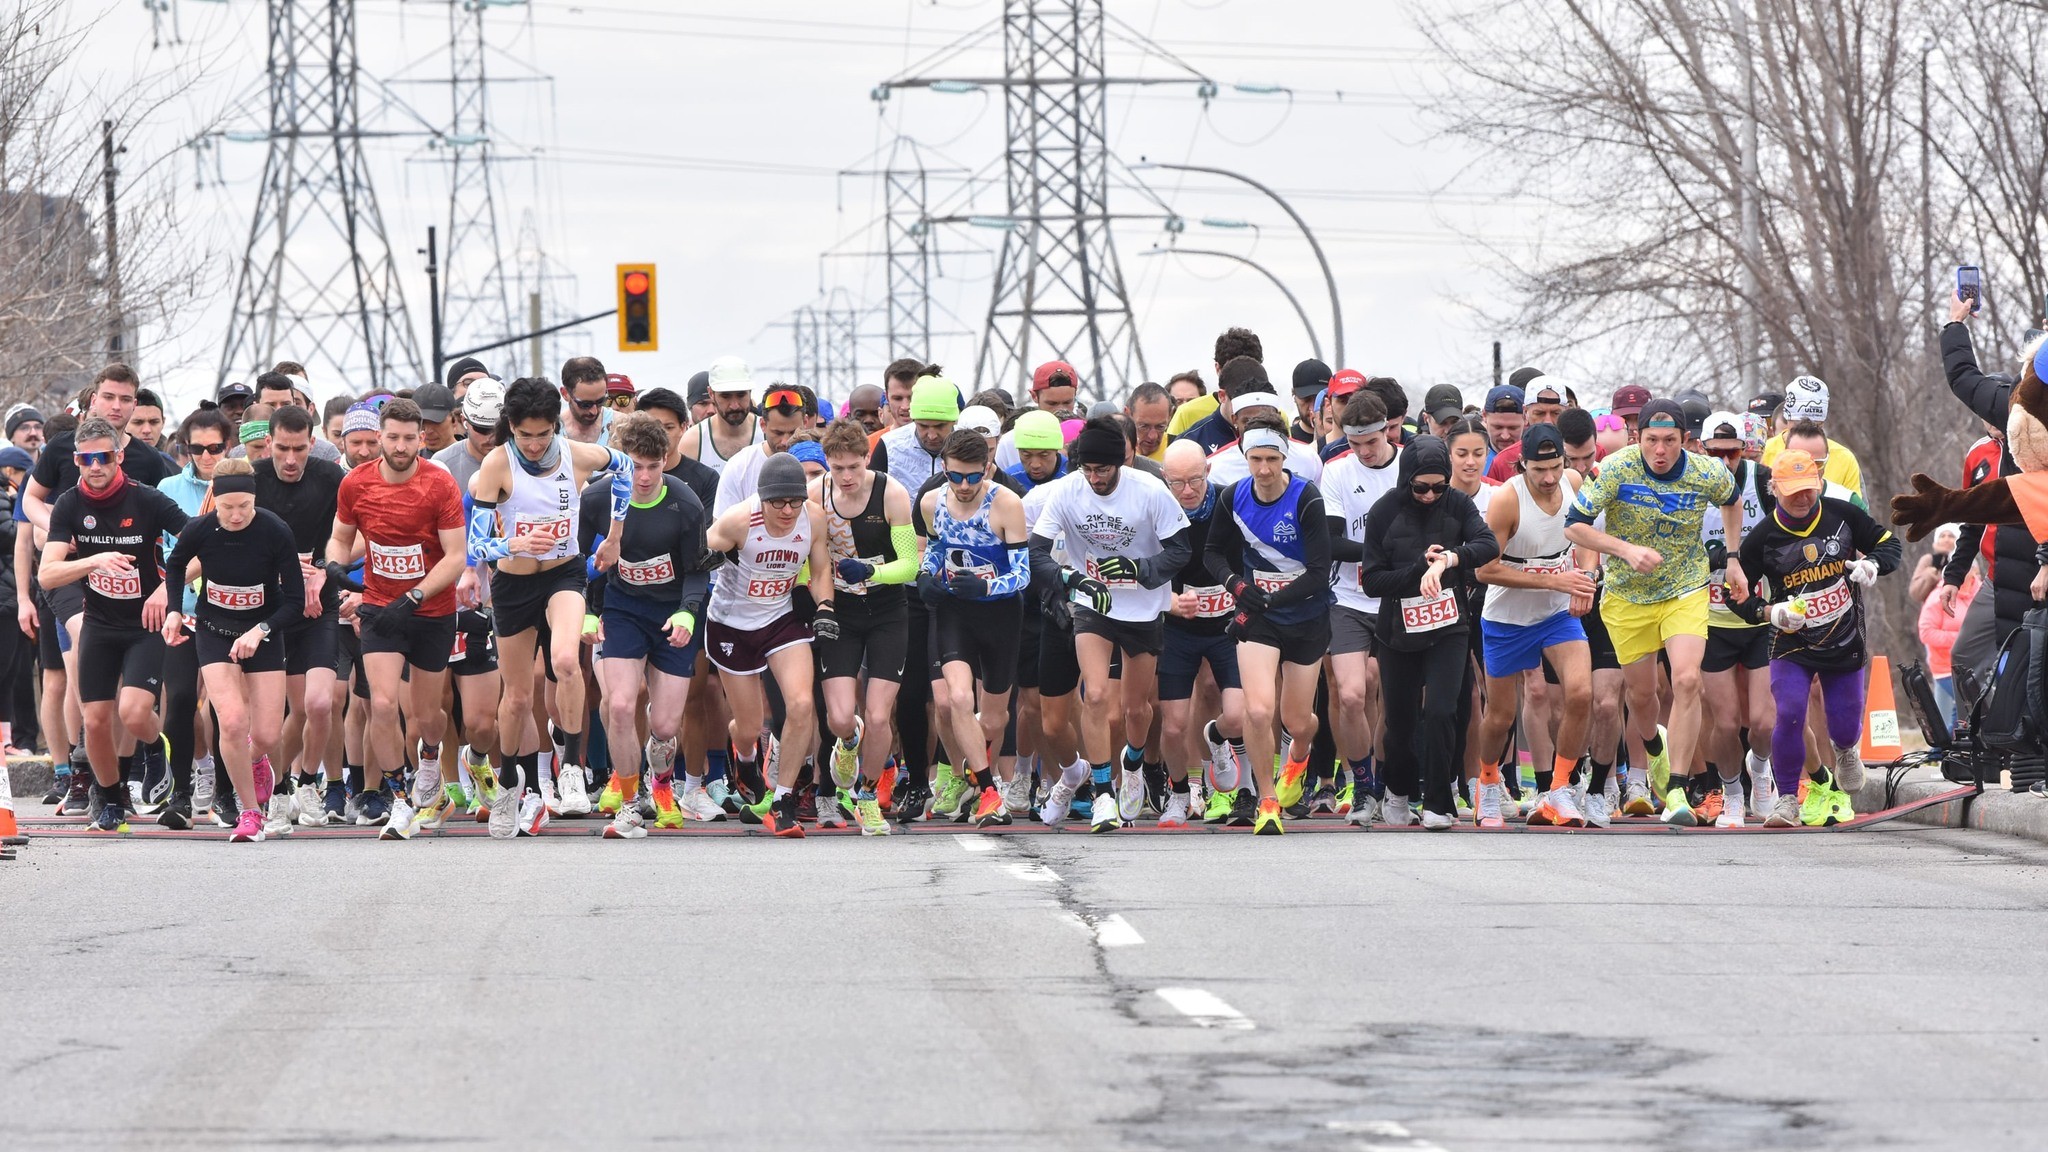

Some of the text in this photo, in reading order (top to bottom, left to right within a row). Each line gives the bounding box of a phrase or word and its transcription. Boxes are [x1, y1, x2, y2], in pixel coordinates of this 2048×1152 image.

[1107, 516, 1123, 524] DE
[518, 521, 568, 537] 376
[90, 535, 114, 544] VALLEY
[115, 535, 143, 545] HARRIERS
[374, 553, 421, 573] 3484
[755, 549, 799, 564] OTTAWA
[621, 564, 670, 581] 3833
[1784, 559, 1845, 589] GERMANY
[90, 572, 137, 594] 3650
[210, 590, 261, 606] 3756
[1199, 592, 1233, 611] 578
[1406, 600, 1455, 626] 3554
